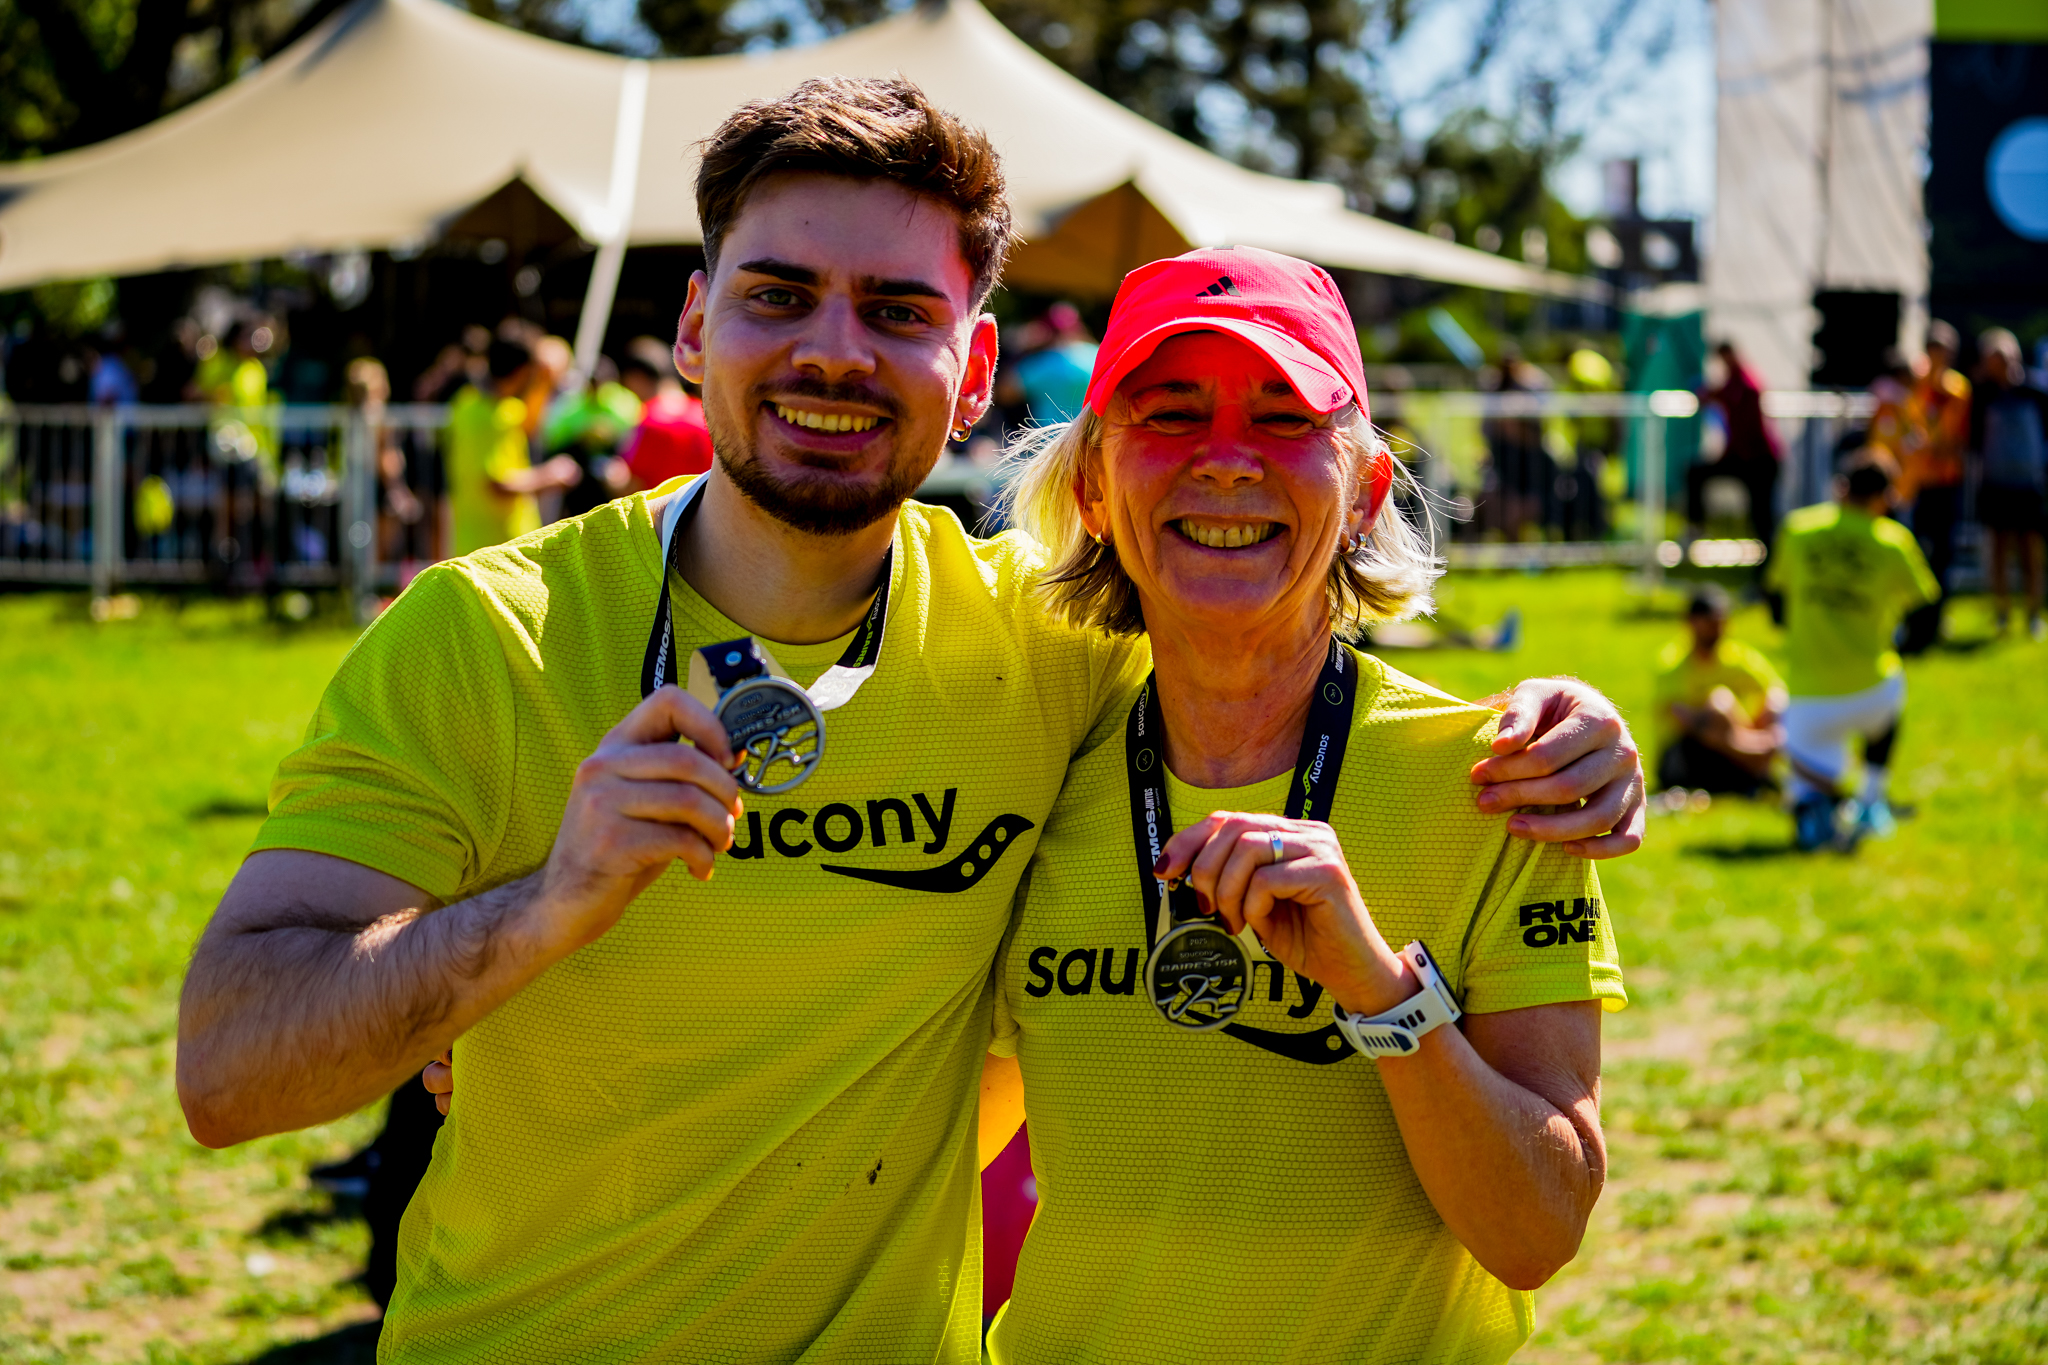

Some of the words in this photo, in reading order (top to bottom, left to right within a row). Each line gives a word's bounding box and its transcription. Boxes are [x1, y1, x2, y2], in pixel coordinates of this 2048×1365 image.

[653, 619, 672, 692] REMOS
[853, 631, 874, 668] BAIRES
[1138, 692, 1147, 737] saucony
[1310, 733, 1329, 784] saucony
[725, 787, 958, 860] ucony
[1301, 798, 1313, 820] BA
[1179, 950, 1214, 959] saucony
[1522, 920, 1596, 948] ONE
[1024, 946, 1325, 1019] sauny
[1160, 961, 1212, 973] BAIRES
[1214, 958, 1239, 967] 15K
